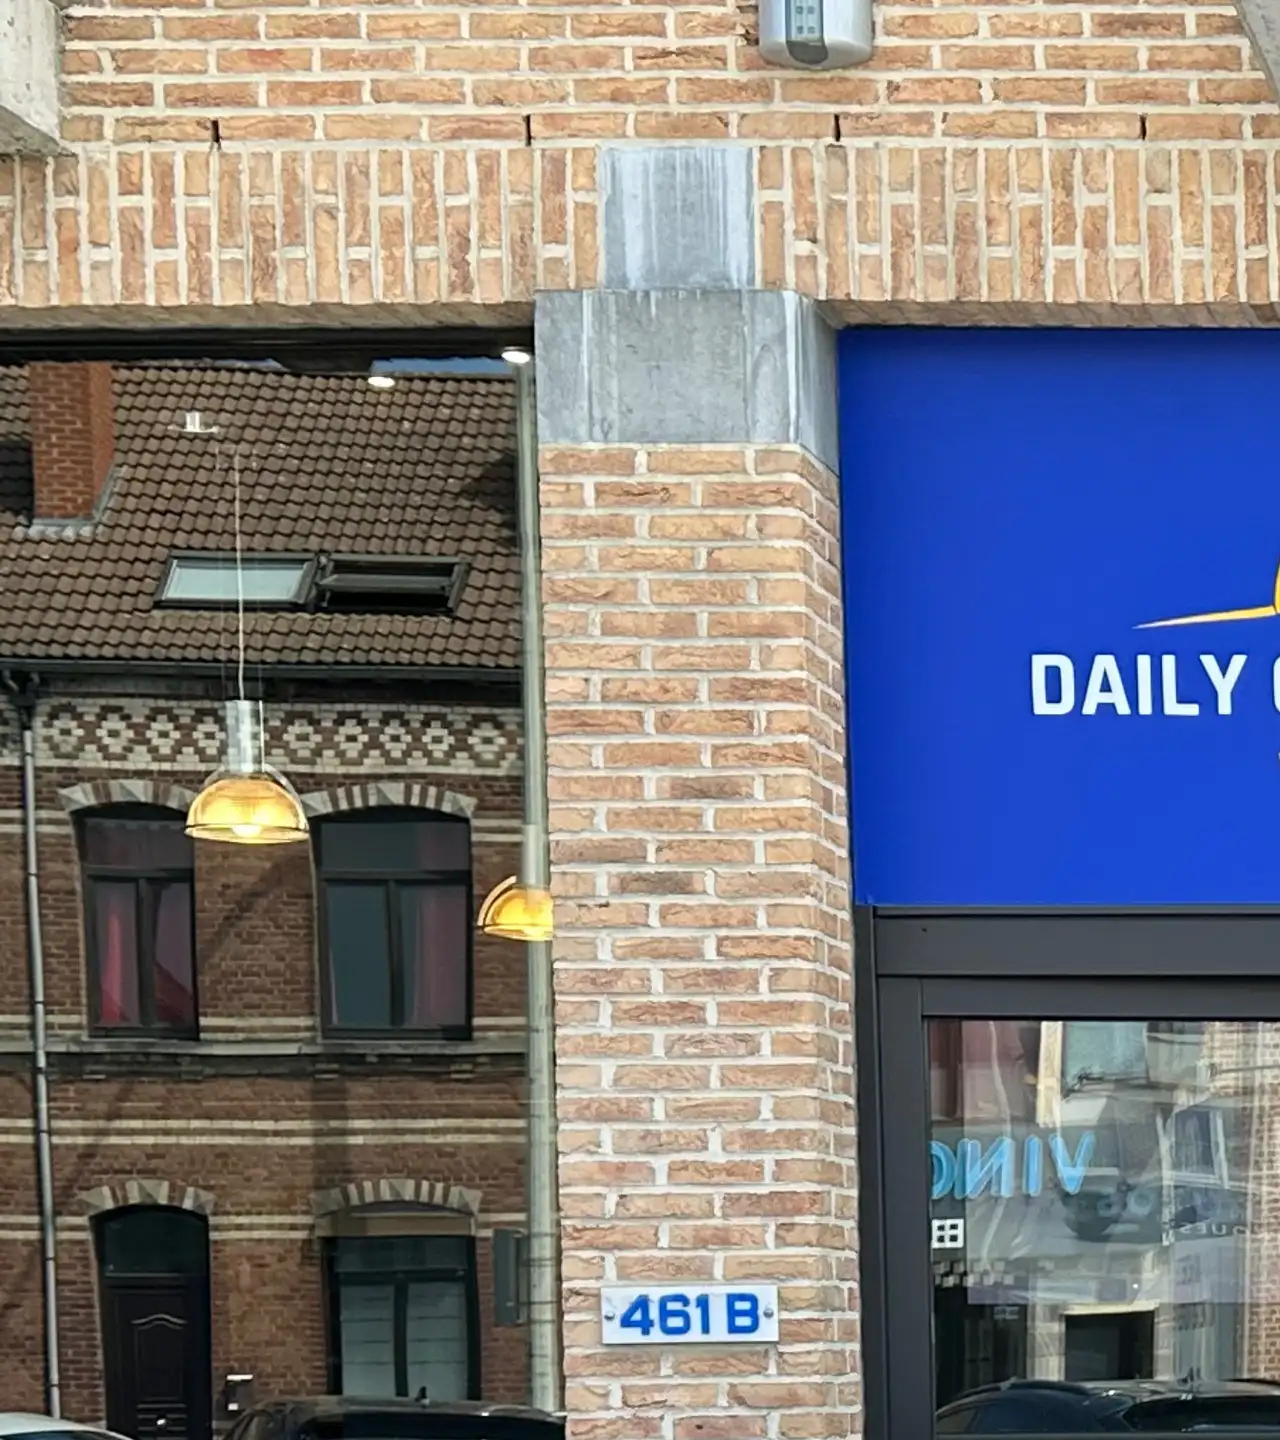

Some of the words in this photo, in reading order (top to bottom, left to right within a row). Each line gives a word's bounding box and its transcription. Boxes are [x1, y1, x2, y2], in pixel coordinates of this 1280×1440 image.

[1031, 653, 1248, 716] DAILY
[619, 1293, 711, 1336] 461
[726, 1292, 760, 1335] B
